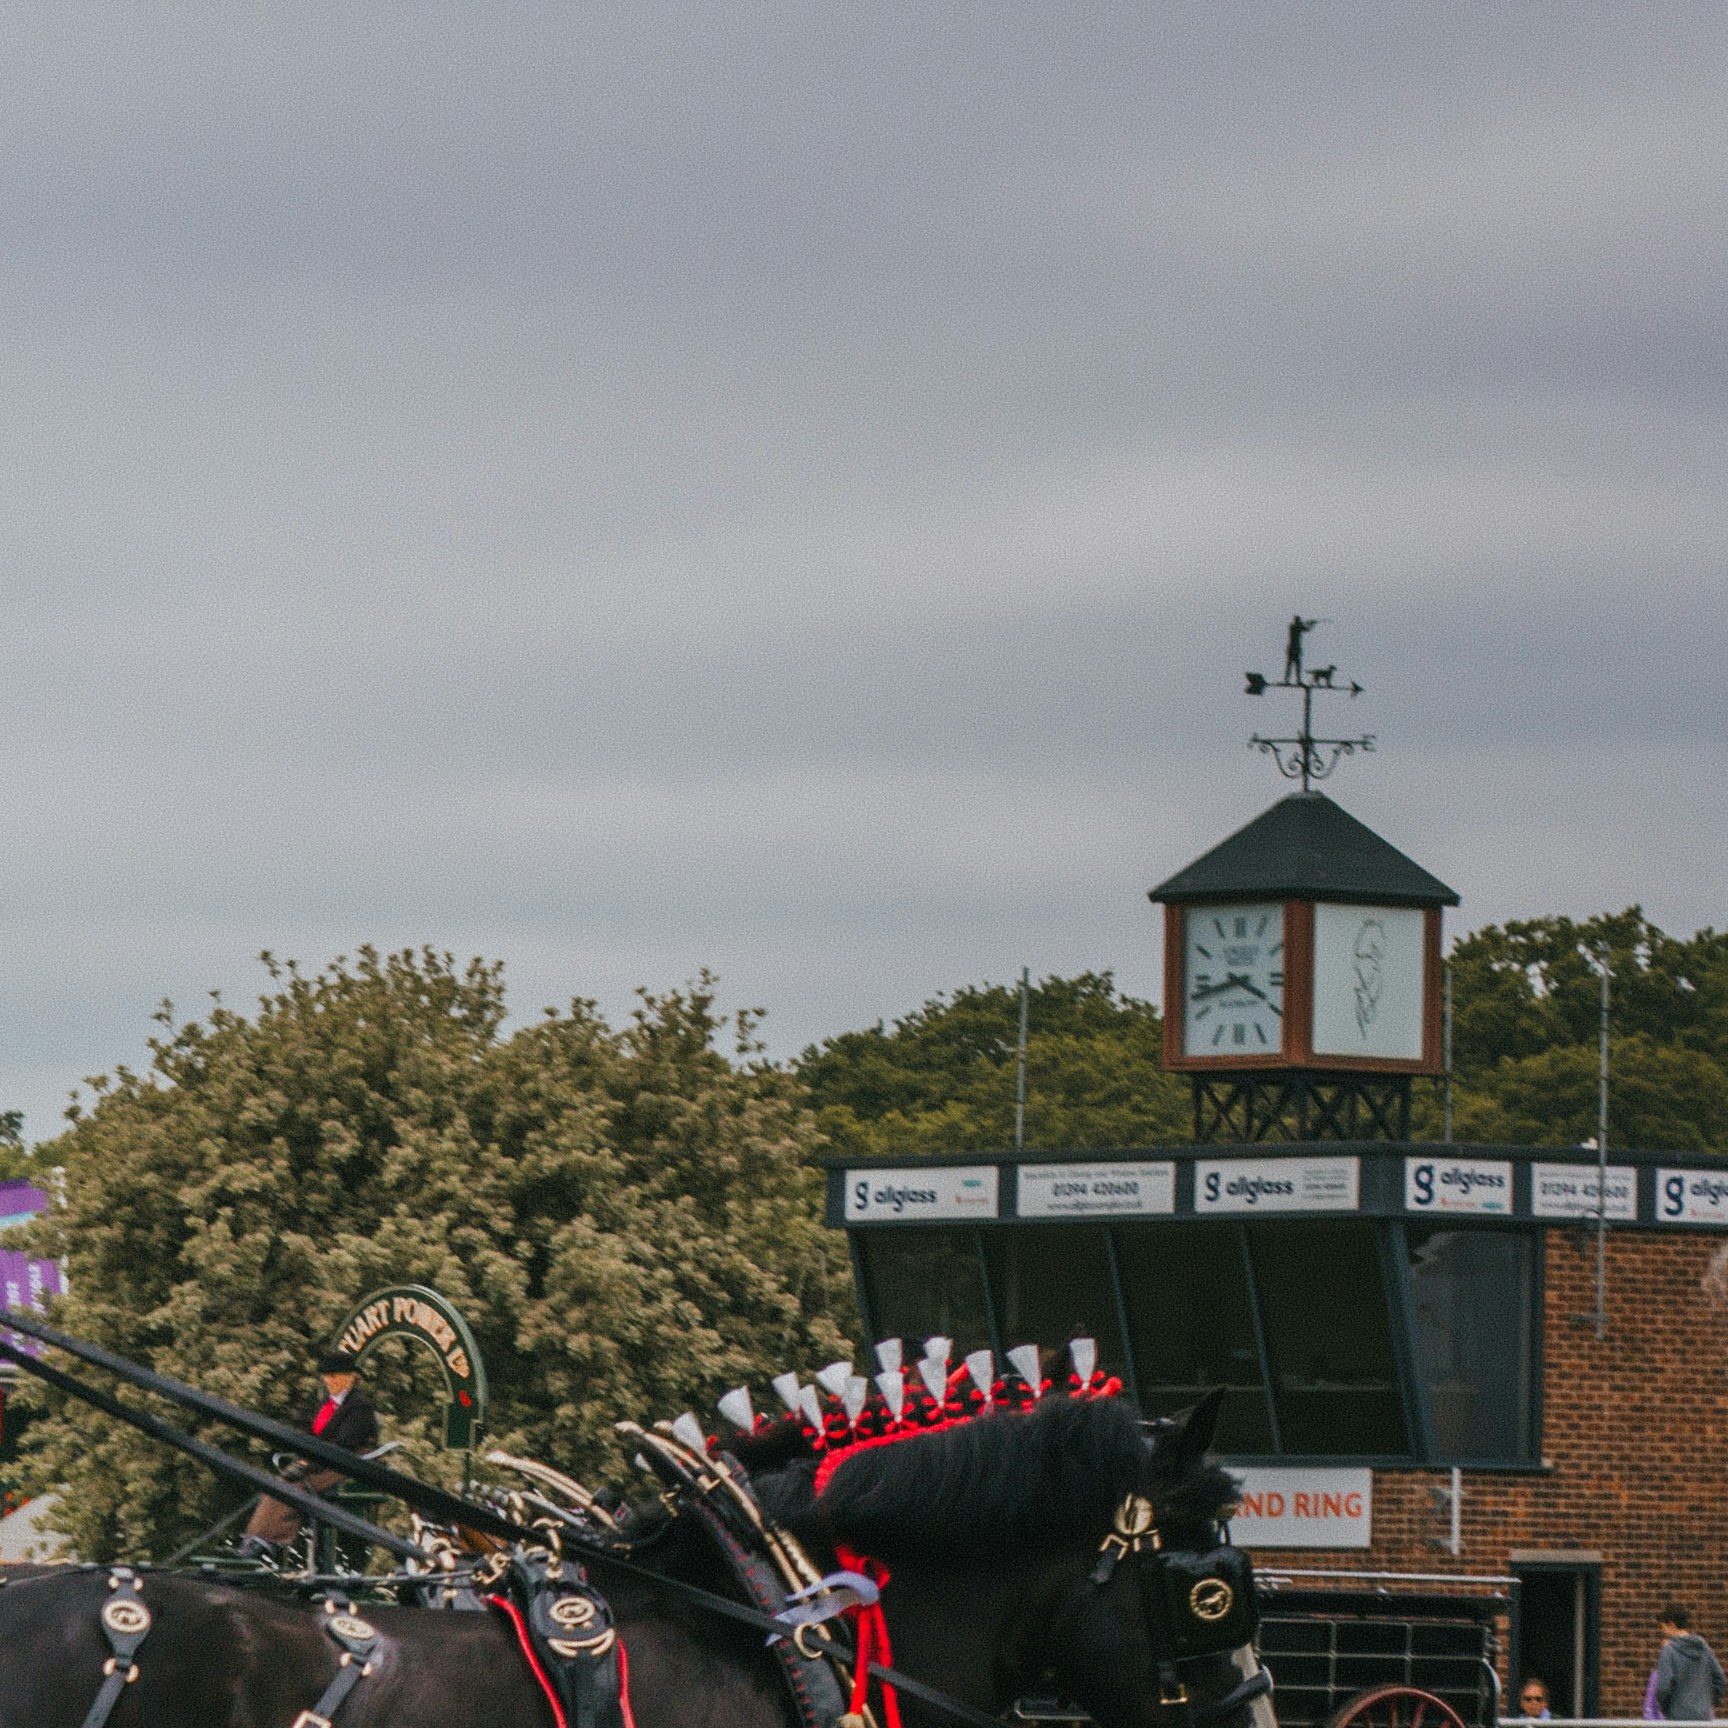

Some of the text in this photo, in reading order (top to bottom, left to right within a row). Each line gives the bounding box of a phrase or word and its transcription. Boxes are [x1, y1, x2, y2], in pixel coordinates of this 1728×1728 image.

[1226, 1175, 1293, 1204] allglass
[1440, 1166, 1505, 1195] allglass
[875, 1185, 937, 1212] allglass
[1294, 1491, 1363, 1519] RING
